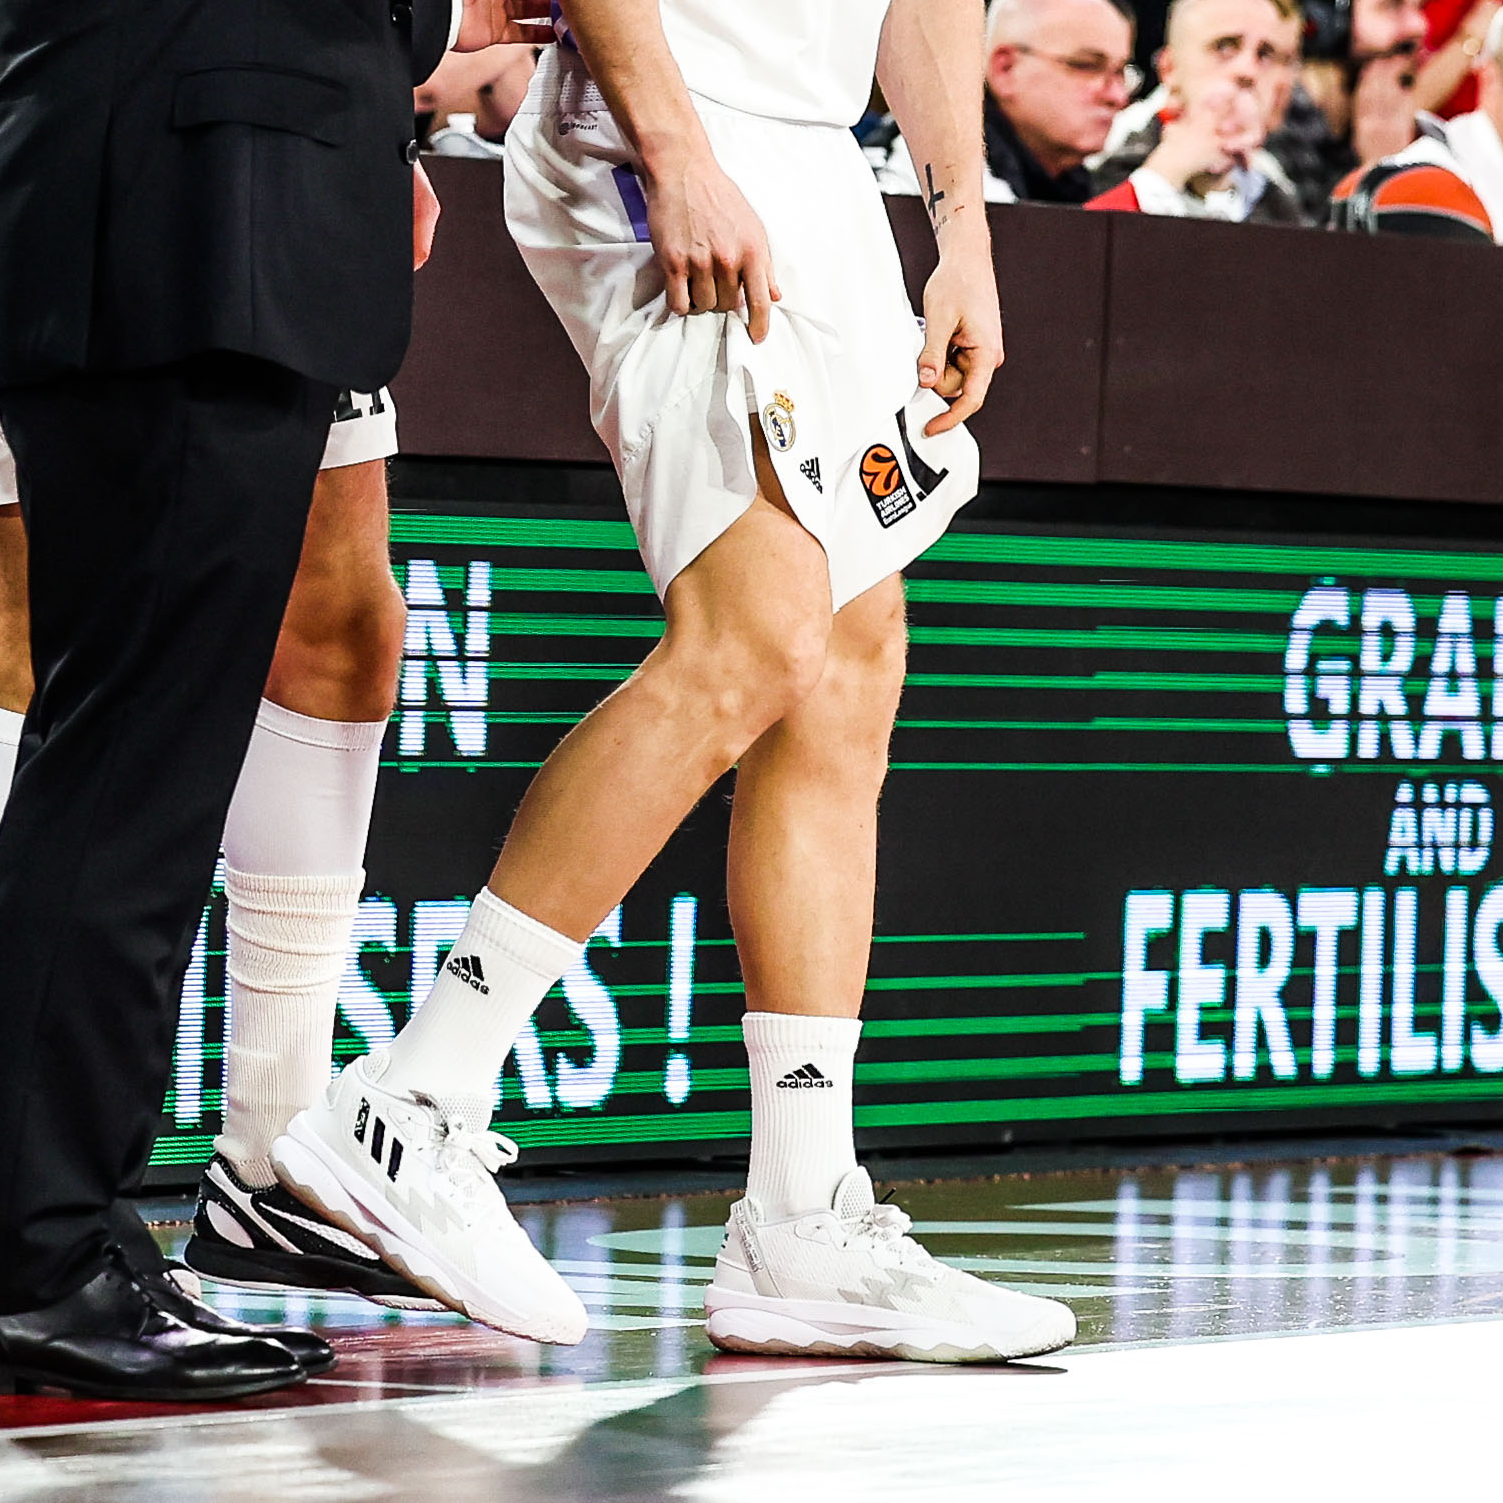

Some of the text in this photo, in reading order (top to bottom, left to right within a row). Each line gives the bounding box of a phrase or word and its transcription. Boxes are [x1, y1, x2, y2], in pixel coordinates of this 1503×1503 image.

[876, 488, 908, 511] TURKISH
[880, 495, 911, 518] AIRLINES
[1384, 780, 1494, 876] AND
[447, 961, 489, 995] adidas
[776, 1077, 833, 1089] adidas
